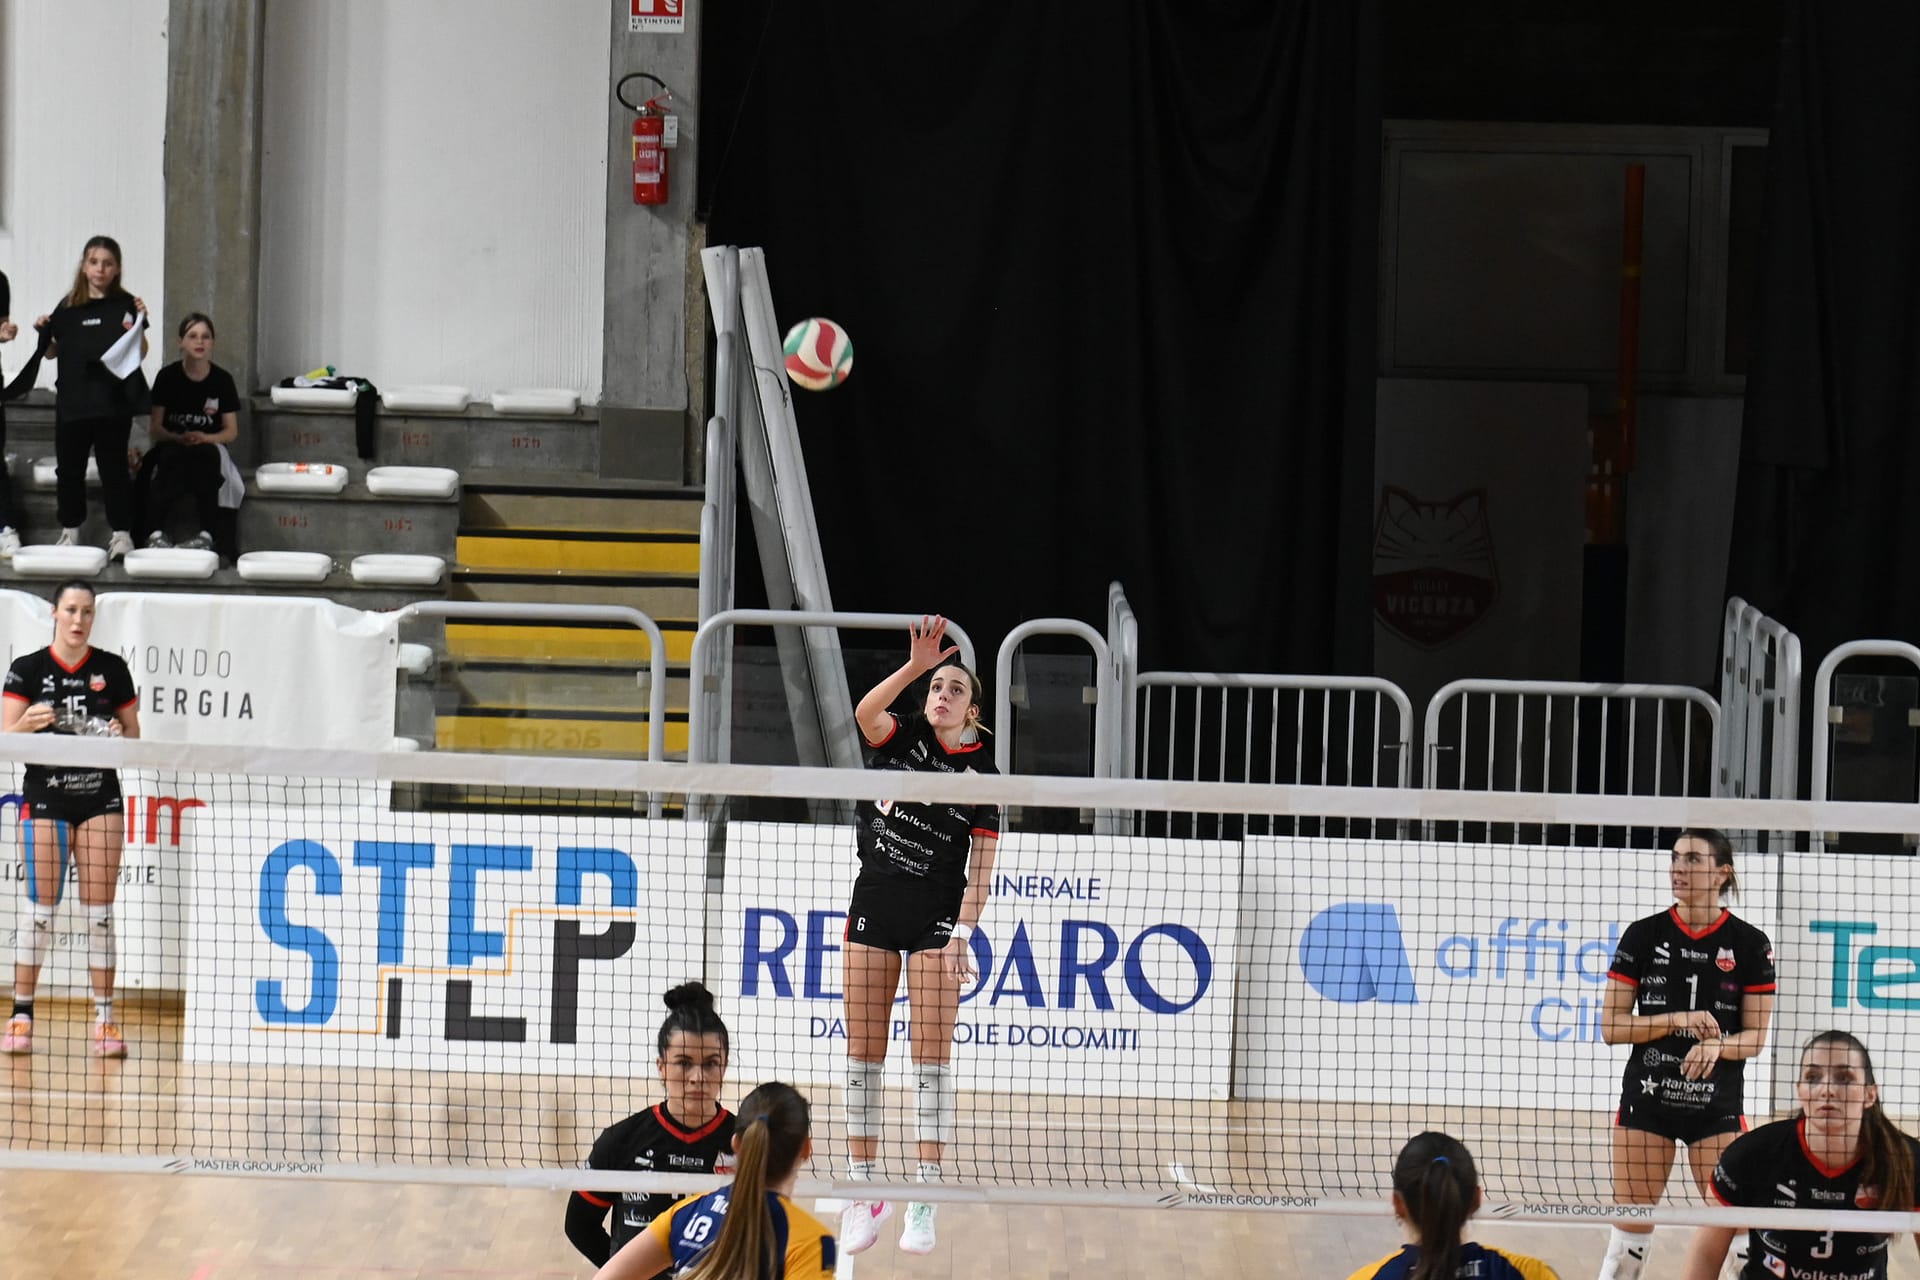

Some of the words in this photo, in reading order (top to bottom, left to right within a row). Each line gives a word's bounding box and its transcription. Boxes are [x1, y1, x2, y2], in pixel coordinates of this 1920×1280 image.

[1386, 594, 1477, 616] VICENZA
[121, 645, 232, 679] MONDO
[137, 685, 254, 720] ERGIA
[987, 873, 1101, 900] INERALE
[856, 916, 866, 931] 6
[255, 838, 639, 1044] STEP
[1685, 974, 1699, 1010] 1
[893, 1020, 1000, 1046] PIOLE
[1008, 1024, 1137, 1051] DOLOMITI
[1661, 1078, 1715, 1094] Rangers
[194, 1159, 240, 1171] MASTER
[668, 1154, 705, 1166] Telea
[1188, 1193, 1234, 1205] MASTER
[1810, 1188, 1845, 1201] Telea
[1523, 1204, 1570, 1215] MASTER
[1810, 1231, 1834, 1259] 3
